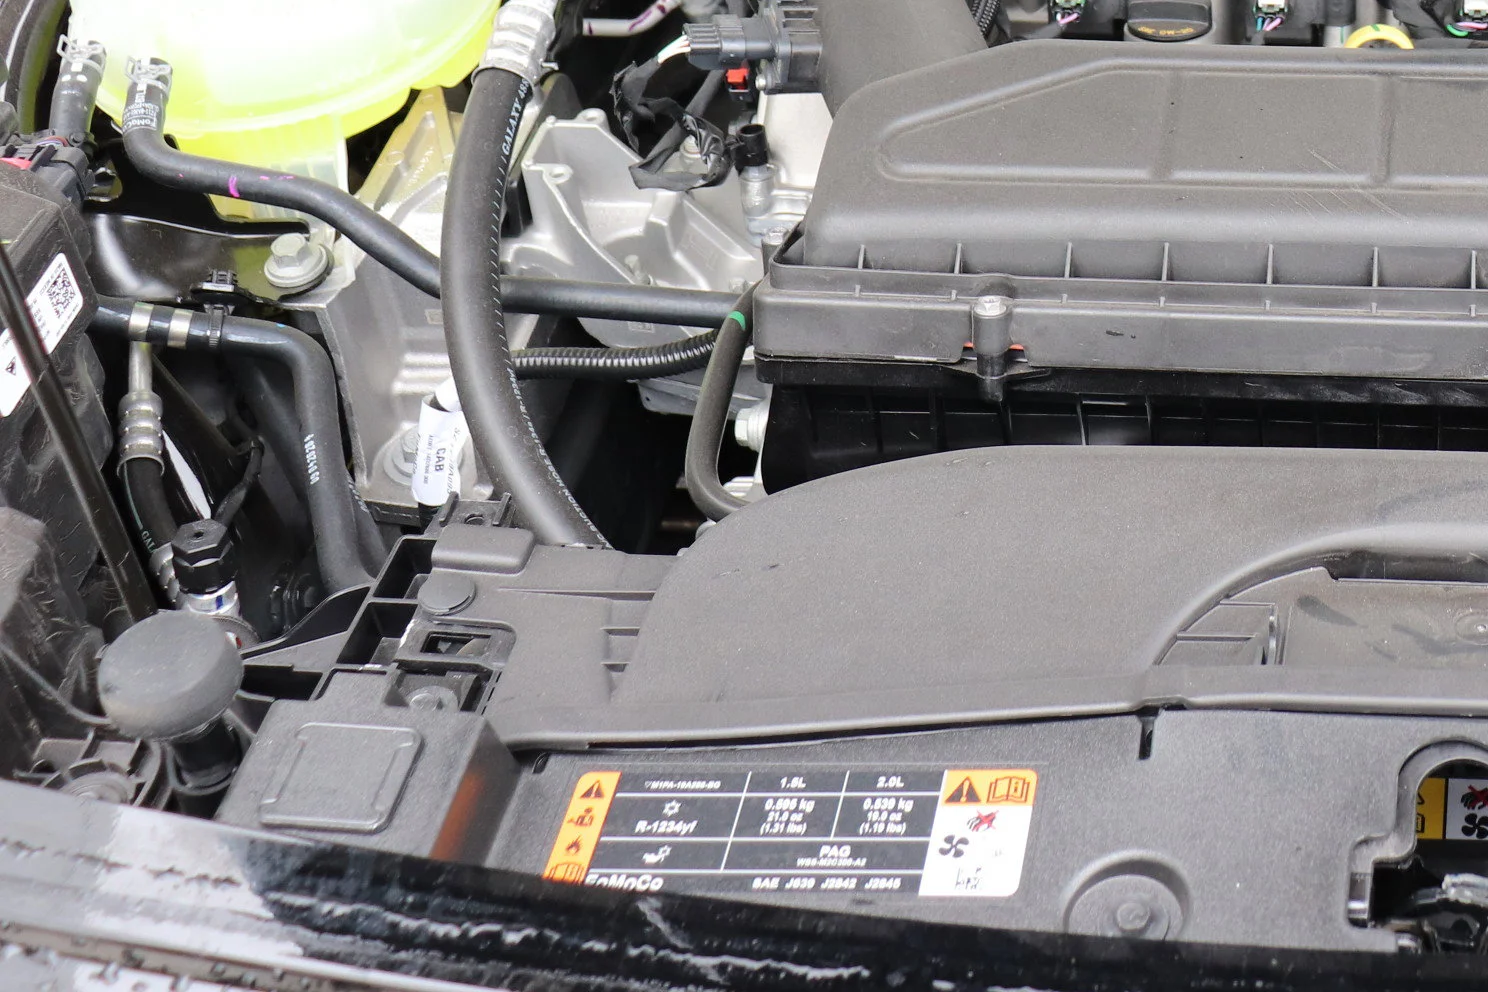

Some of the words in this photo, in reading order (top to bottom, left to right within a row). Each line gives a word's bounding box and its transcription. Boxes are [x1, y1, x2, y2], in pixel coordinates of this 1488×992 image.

[501, 97, 522, 156] GALAXY
[435, 447, 446, 473] CAB
[544, 457, 565, 488] HOSE
[562, 488, 598, 533] SUCTION
[876, 775, 905, 788] 2.0L
[799, 798, 816, 813] kg
[897, 797, 914, 812] kg
[790, 812, 804, 822] oz
[889, 811, 903, 822] oz
[634, 819, 698, 835] R-1234yf
[819, 844, 853, 858] PAG
[752, 876, 780, 889] SAE
